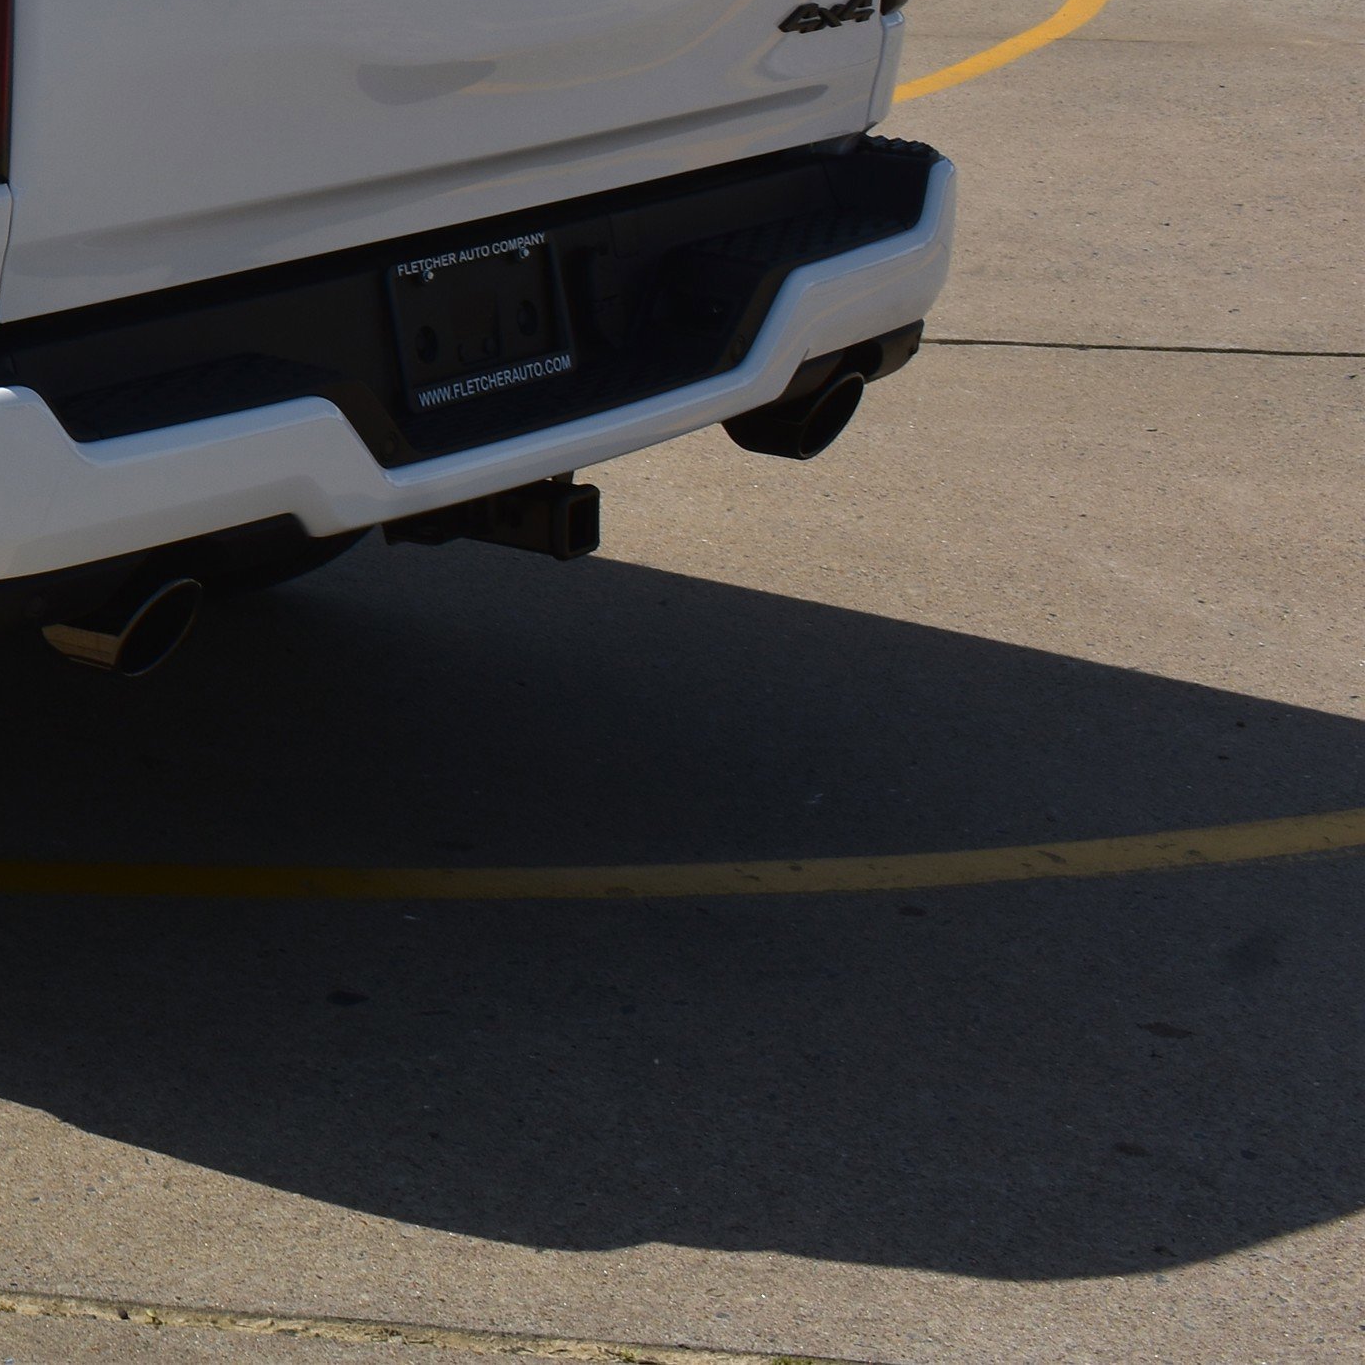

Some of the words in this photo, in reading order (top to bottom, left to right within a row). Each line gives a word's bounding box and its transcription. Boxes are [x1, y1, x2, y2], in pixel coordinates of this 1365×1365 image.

[397, 253, 457, 277] FLETCHER
[459, 245, 490, 263] AUTO
[491, 232, 546, 254] COMPANY
[418, 354, 572, 407] WWW.FLETCHERAUTO.COM
